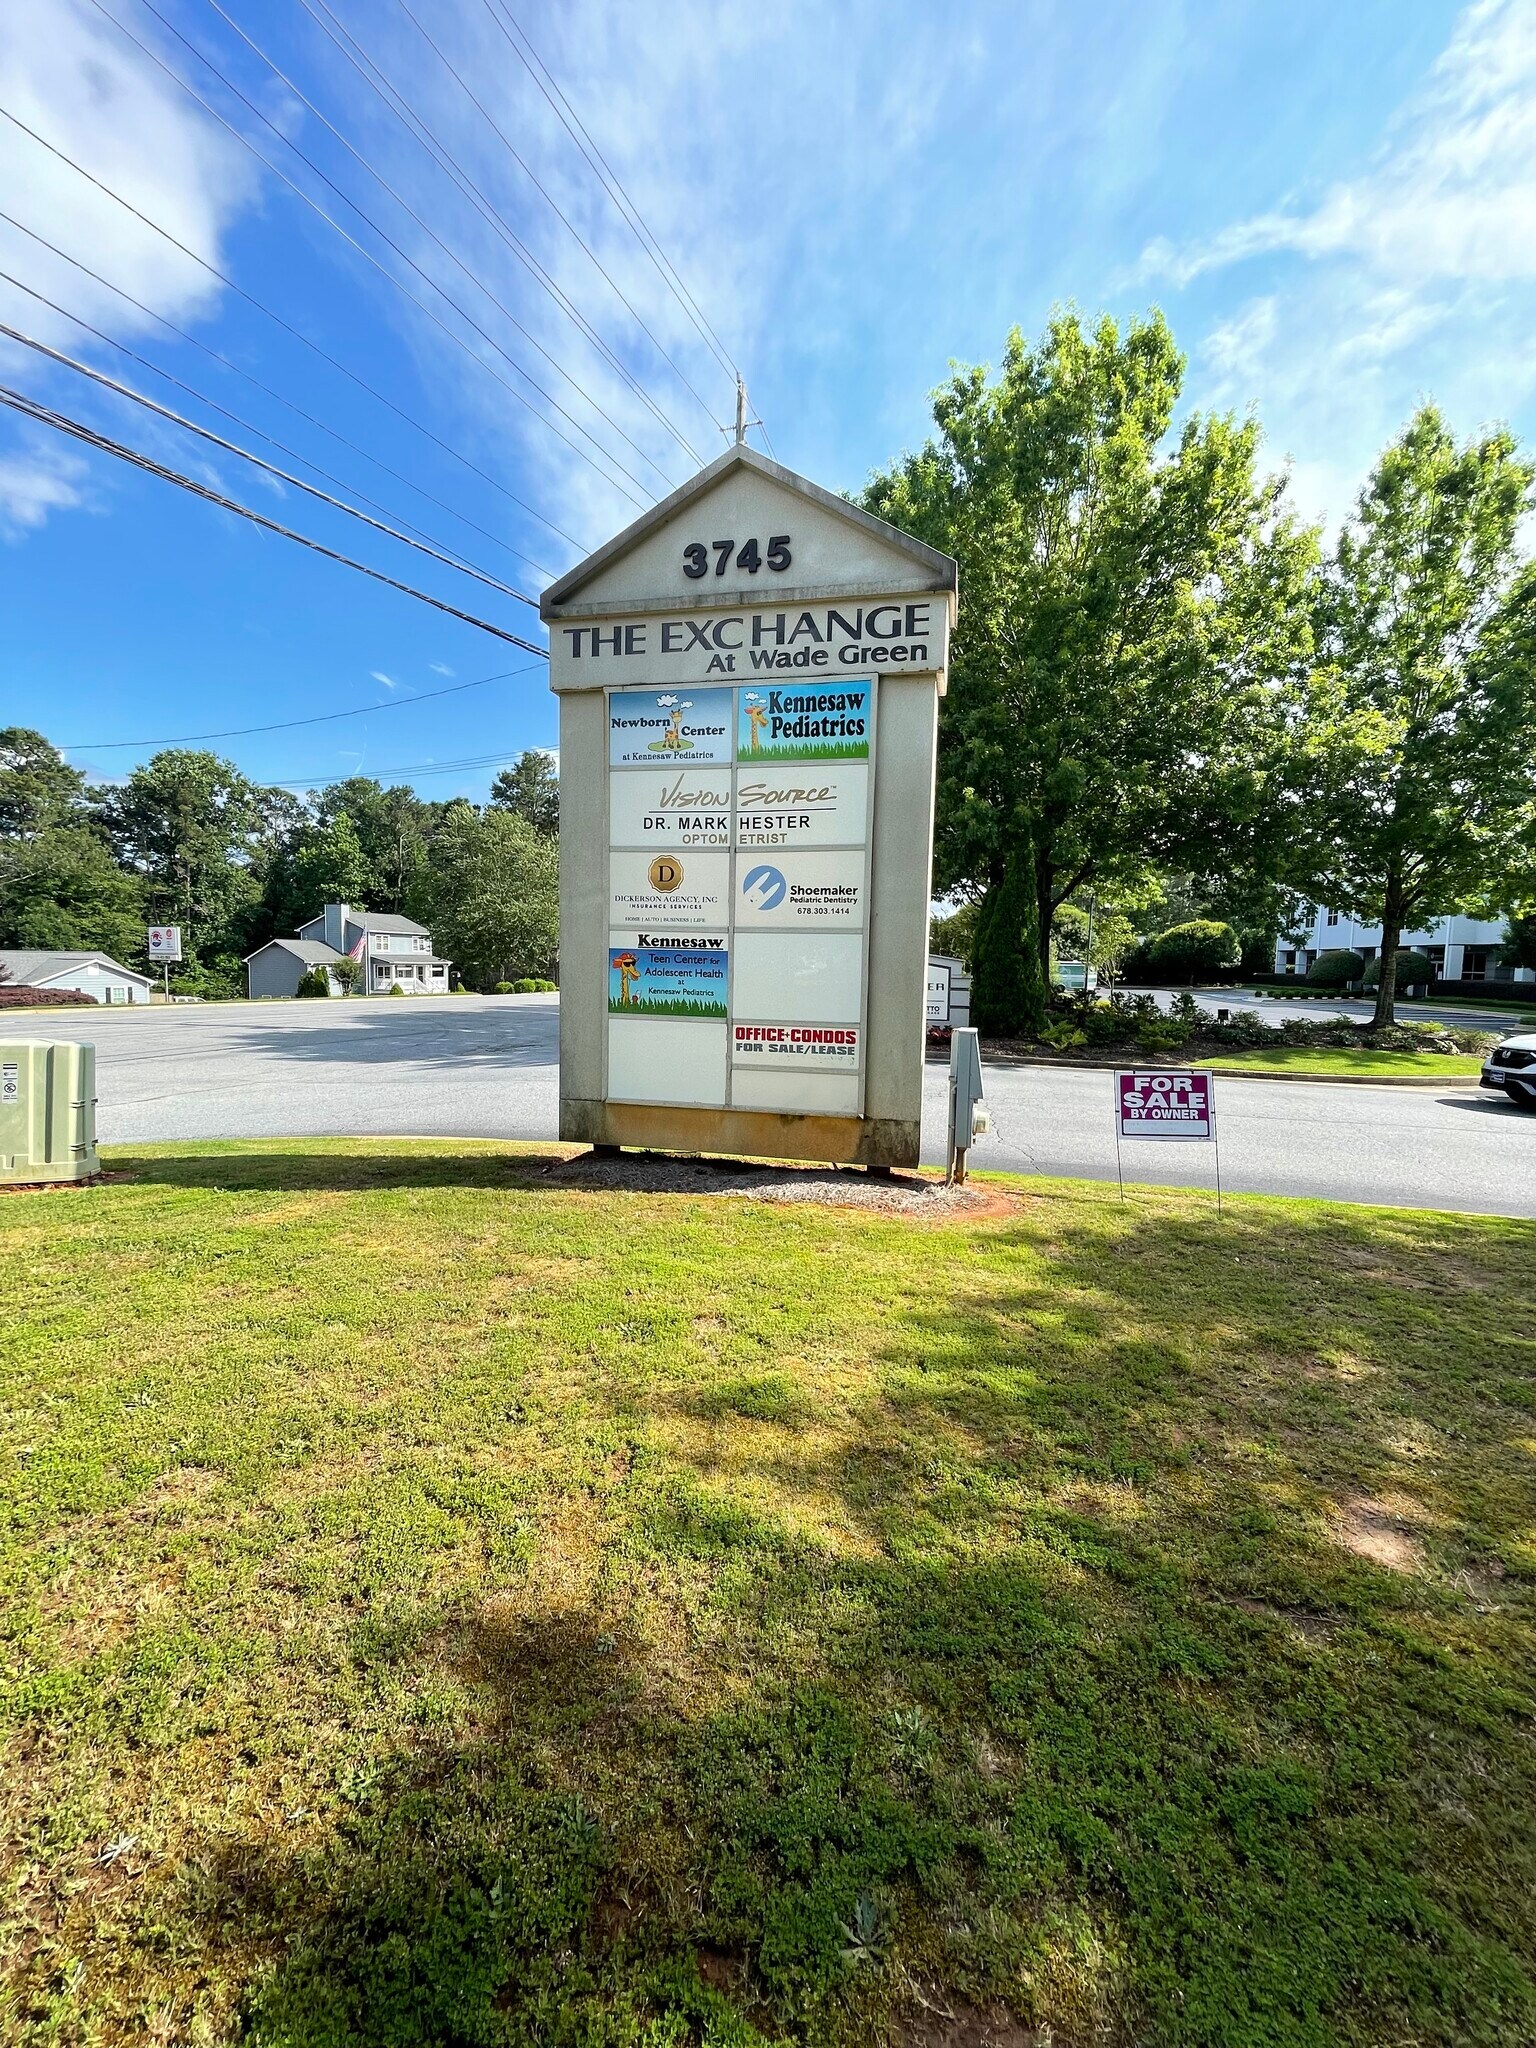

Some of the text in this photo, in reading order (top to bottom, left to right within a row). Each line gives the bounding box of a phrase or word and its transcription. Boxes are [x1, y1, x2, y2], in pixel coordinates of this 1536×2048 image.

[683, 535, 791, 578] 3745
[563, 603, 931, 658] THE EXCHANGE
[706, 644, 928, 673] At Wade Green
[769, 691, 865, 714] Kennesaw
[611, 718, 725, 736] Newborn Center
[771, 714, 864, 738] Pediatrics
[632, 752, 672, 761] Kennesaw
[673, 751, 714, 760] Pediatrics
[643, 815, 811, 830] DR. MARK HESTER
[658, 865, 675, 882] D
[790, 885, 858, 895] Shoemaker
[824, 897, 858, 905] Dentistry
[638, 934, 724, 948] Kennesaw
[648, 954, 720, 965] Teen Center for
[645, 967, 724, 979] Adolescent Health
[648, 987, 715, 997] Kennesaw Pediatrics
[736, 1042, 855, 1056] FOR SALE/LEASE
[1134, 1077, 1193, 1092] FOR
[1123, 1091, 1206, 1109] SALE
[1130, 1108, 1199, 1120] BY OWNER
